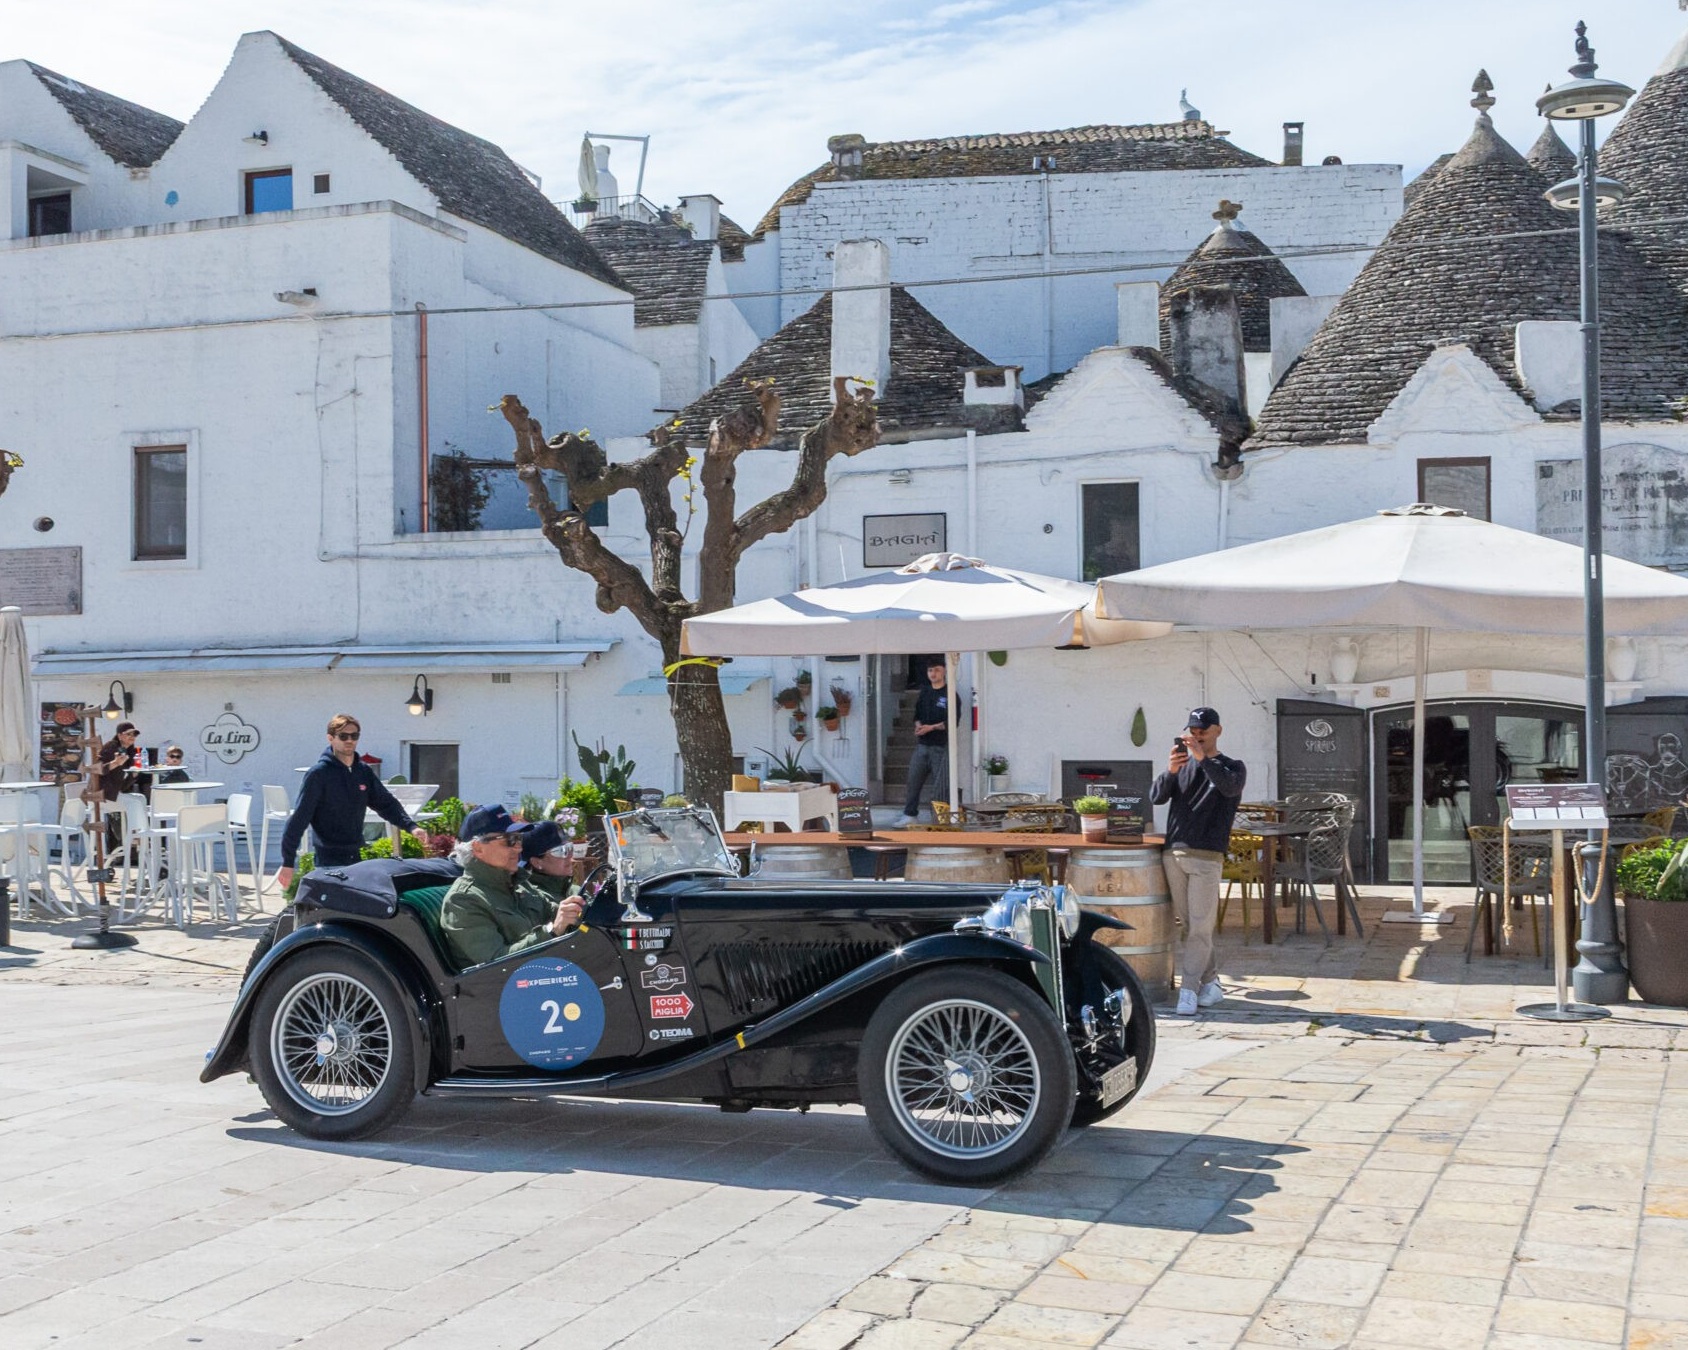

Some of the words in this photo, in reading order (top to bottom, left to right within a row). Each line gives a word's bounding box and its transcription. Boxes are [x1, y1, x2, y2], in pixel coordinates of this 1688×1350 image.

[204, 731, 222, 744] La
[224, 731, 251, 744] Lira
[655, 998, 681, 1006] 1000
[541, 1000, 563, 1034] 2
[655, 1007, 684, 1016] MIGLIA
